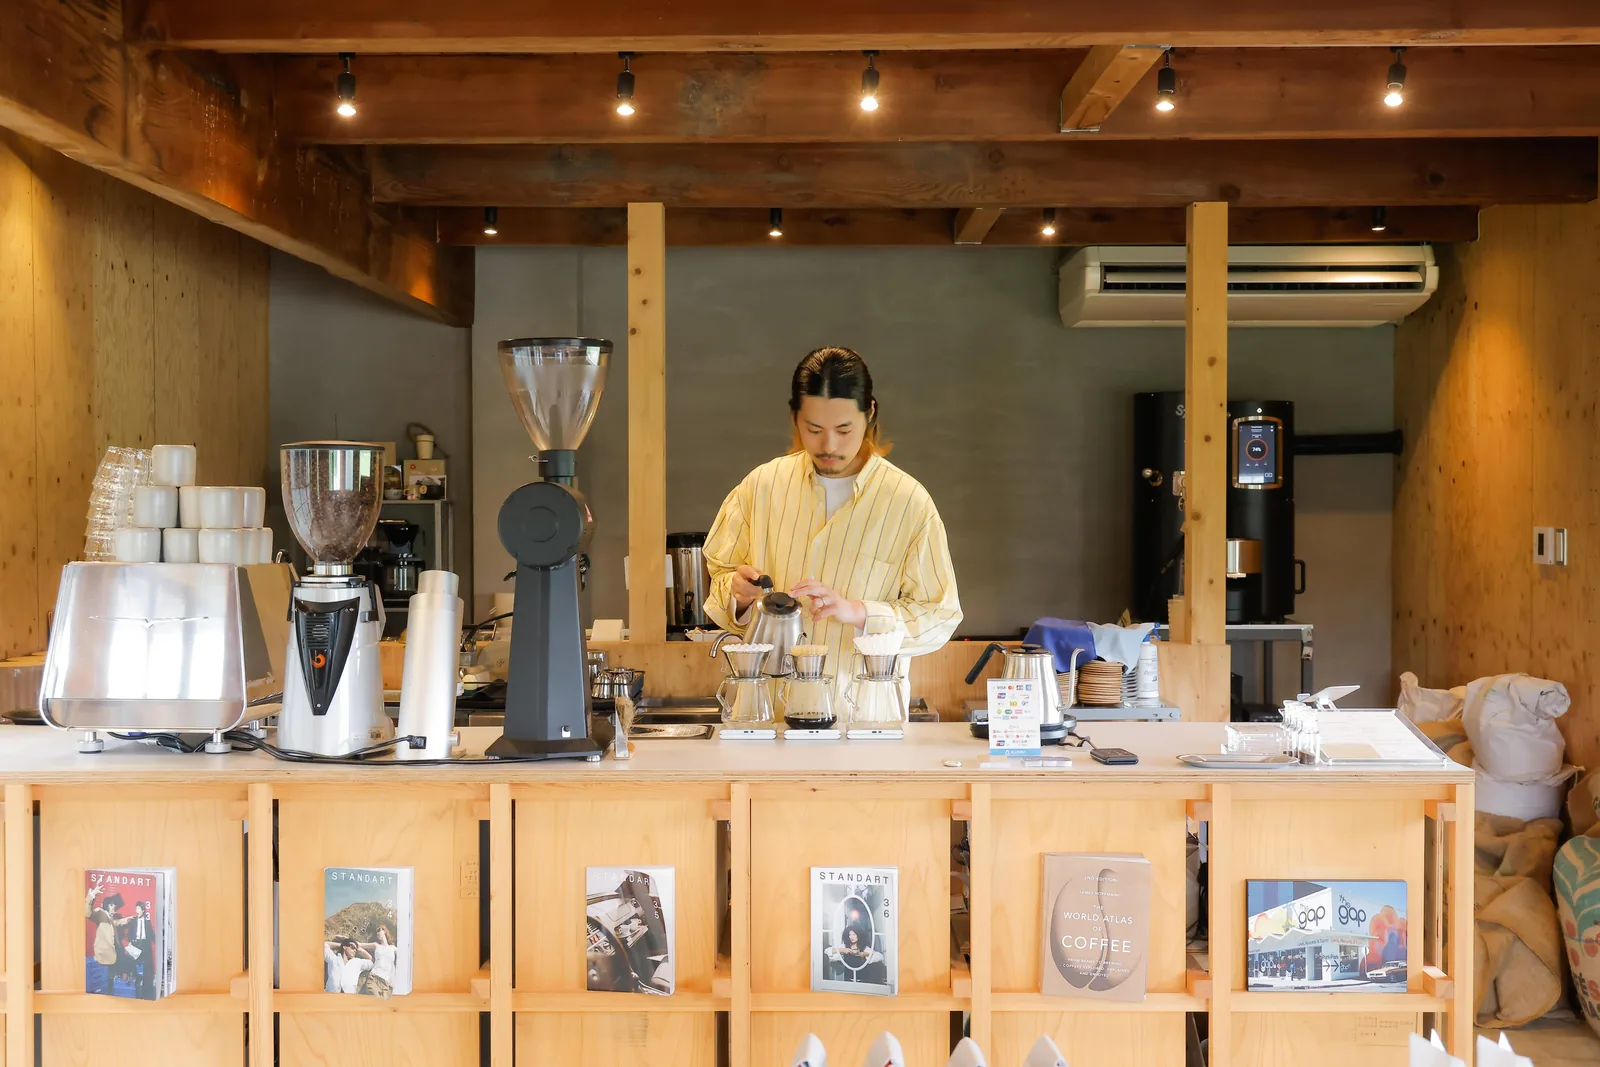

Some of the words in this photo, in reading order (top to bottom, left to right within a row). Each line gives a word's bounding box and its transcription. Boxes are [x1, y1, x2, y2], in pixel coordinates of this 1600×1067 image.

[90, 873, 152, 887] STANDART
[331, 871, 393, 885] STANDART
[595, 870, 656, 886] STANDAR
[819, 871, 889, 885] STANDART
[1063, 911, 1100, 922] WORLD
[1103, 914, 1133, 925] ATLAS
[1298, 905, 1326, 930] gap
[1338, 905, 1367, 928] gap
[1061, 934, 1131, 953] COFFEE
